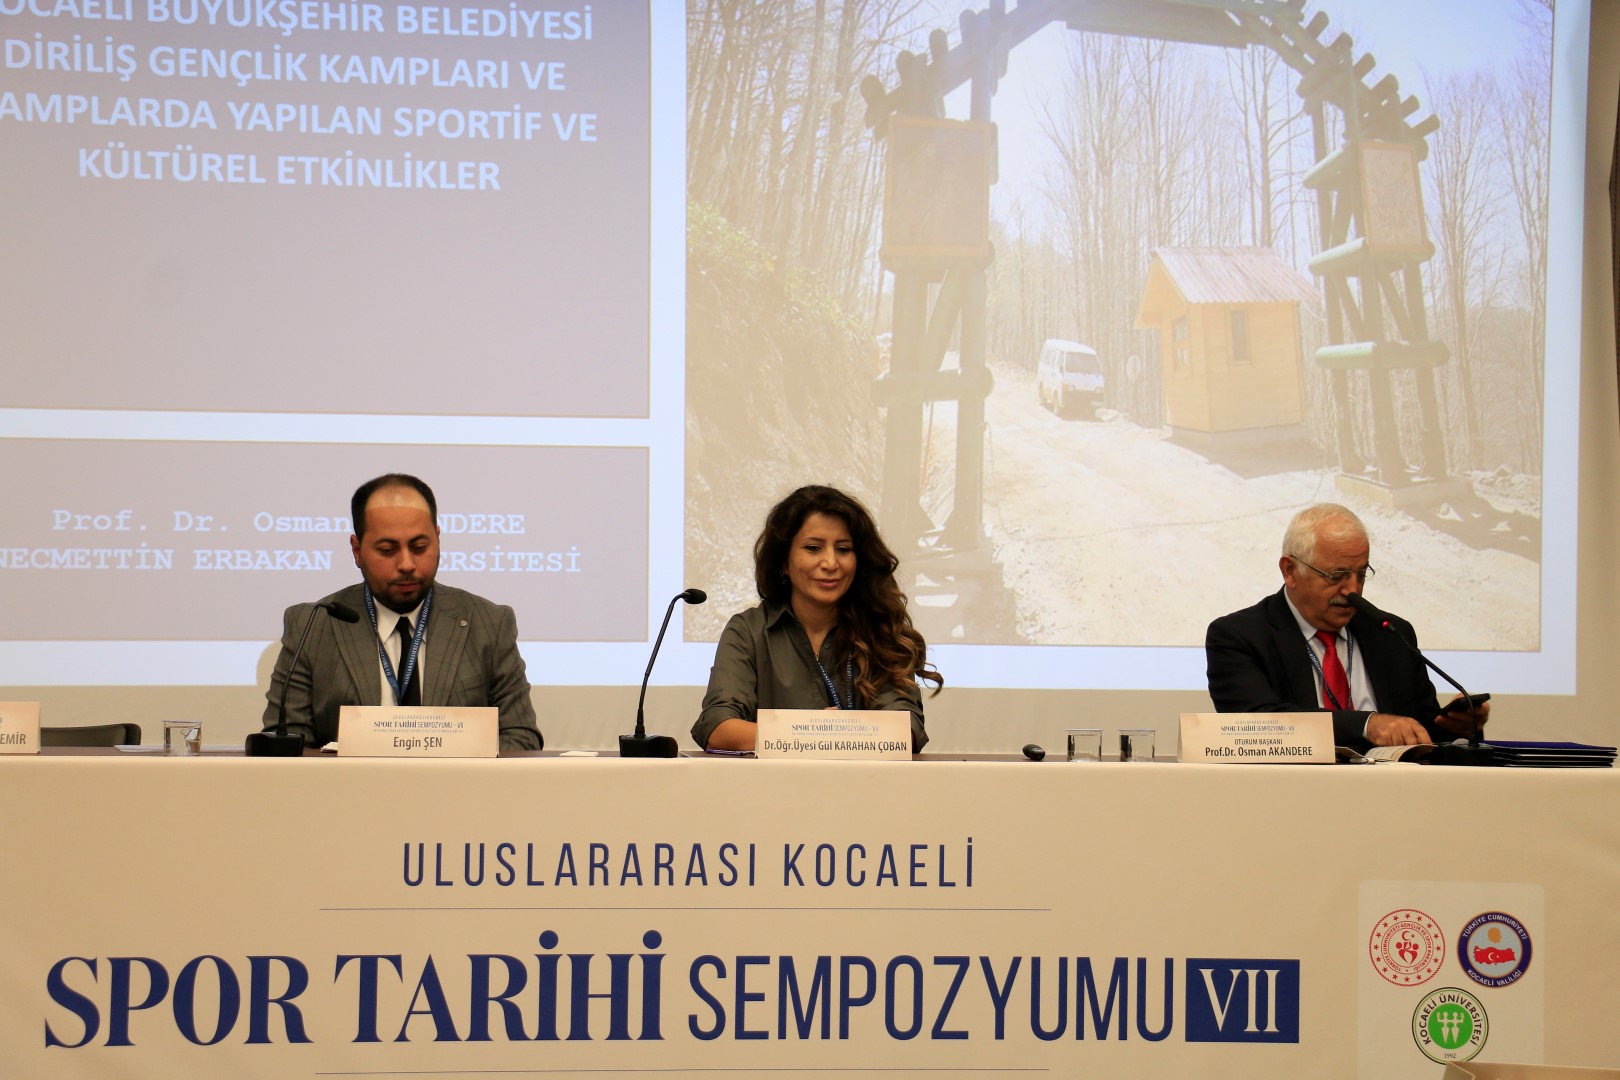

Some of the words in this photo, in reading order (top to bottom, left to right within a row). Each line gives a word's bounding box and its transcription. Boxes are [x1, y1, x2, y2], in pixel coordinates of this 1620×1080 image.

[397, 3, 594, 41] BELEDİYESİ
[5, 32, 138, 82] DİRİLİŞ
[147, 44, 309, 88] GENÇLİK
[319, 51, 511, 91] KAMPLARI
[519, 60, 567, 92] VE
[0, 91, 219, 130] AMPLARDA
[227, 100, 383, 136] YAPILAN
[393, 102, 543, 142] SPORTİF
[551, 111, 599, 143] VE
[79, 141, 267, 184] KÜLTÜREL
[277, 149, 502, 191] ETKİNLİKLER
[53, 509, 148, 532] Prof.
[173, 510, 228, 533] Dr.
[254, 511, 354, 534] Osman
[437, 512, 527, 535] NDERE
[193, 548, 334, 571] ERBAKAN
[438, 543, 583, 574] ERSİTESİ
[394, 720, 417, 728] TARİHİ
[792, 724, 810, 732] SPOR
[811, 723, 833, 731] TARİHİ
[0, 731, 26, 745] EMİR
[393, 736, 421, 751] Engin
[423, 736, 443, 751] ŞEN
[818, 740, 833, 751] Gül
[834, 741, 876, 751] KARAHAN
[878, 741, 907, 754] ÇOBAN
[1258, 738, 1283, 747] BAŞKANI
[1238, 746, 1267, 757] Osman
[1268, 746, 1313, 757] AKANDERE
[403, 842, 756, 887] ULUSLARARASI
[784, 836, 973, 888] KOCAELİ
[1462, 915, 1487, 938] TÜRKİYE
[1487, 914, 1529, 940] CUMHURİYETİ
[45, 954, 314, 1049] SPOR
[334, 929, 666, 1043] TARİHİ
[688, 954, 1174, 1042] SEMPOZYUMU
[1198, 967, 1281, 1033] VII
[1467, 968, 1495, 987] KOCAELİ
[1496, 969, 1523, 987] VALİLİĞİ
[1418, 998, 1438, 1046] KOCAELİ
[1438, 992, 1483, 1047] ÜNİVERSİTESİ
[1443, 1052, 1457, 1060] 1992
